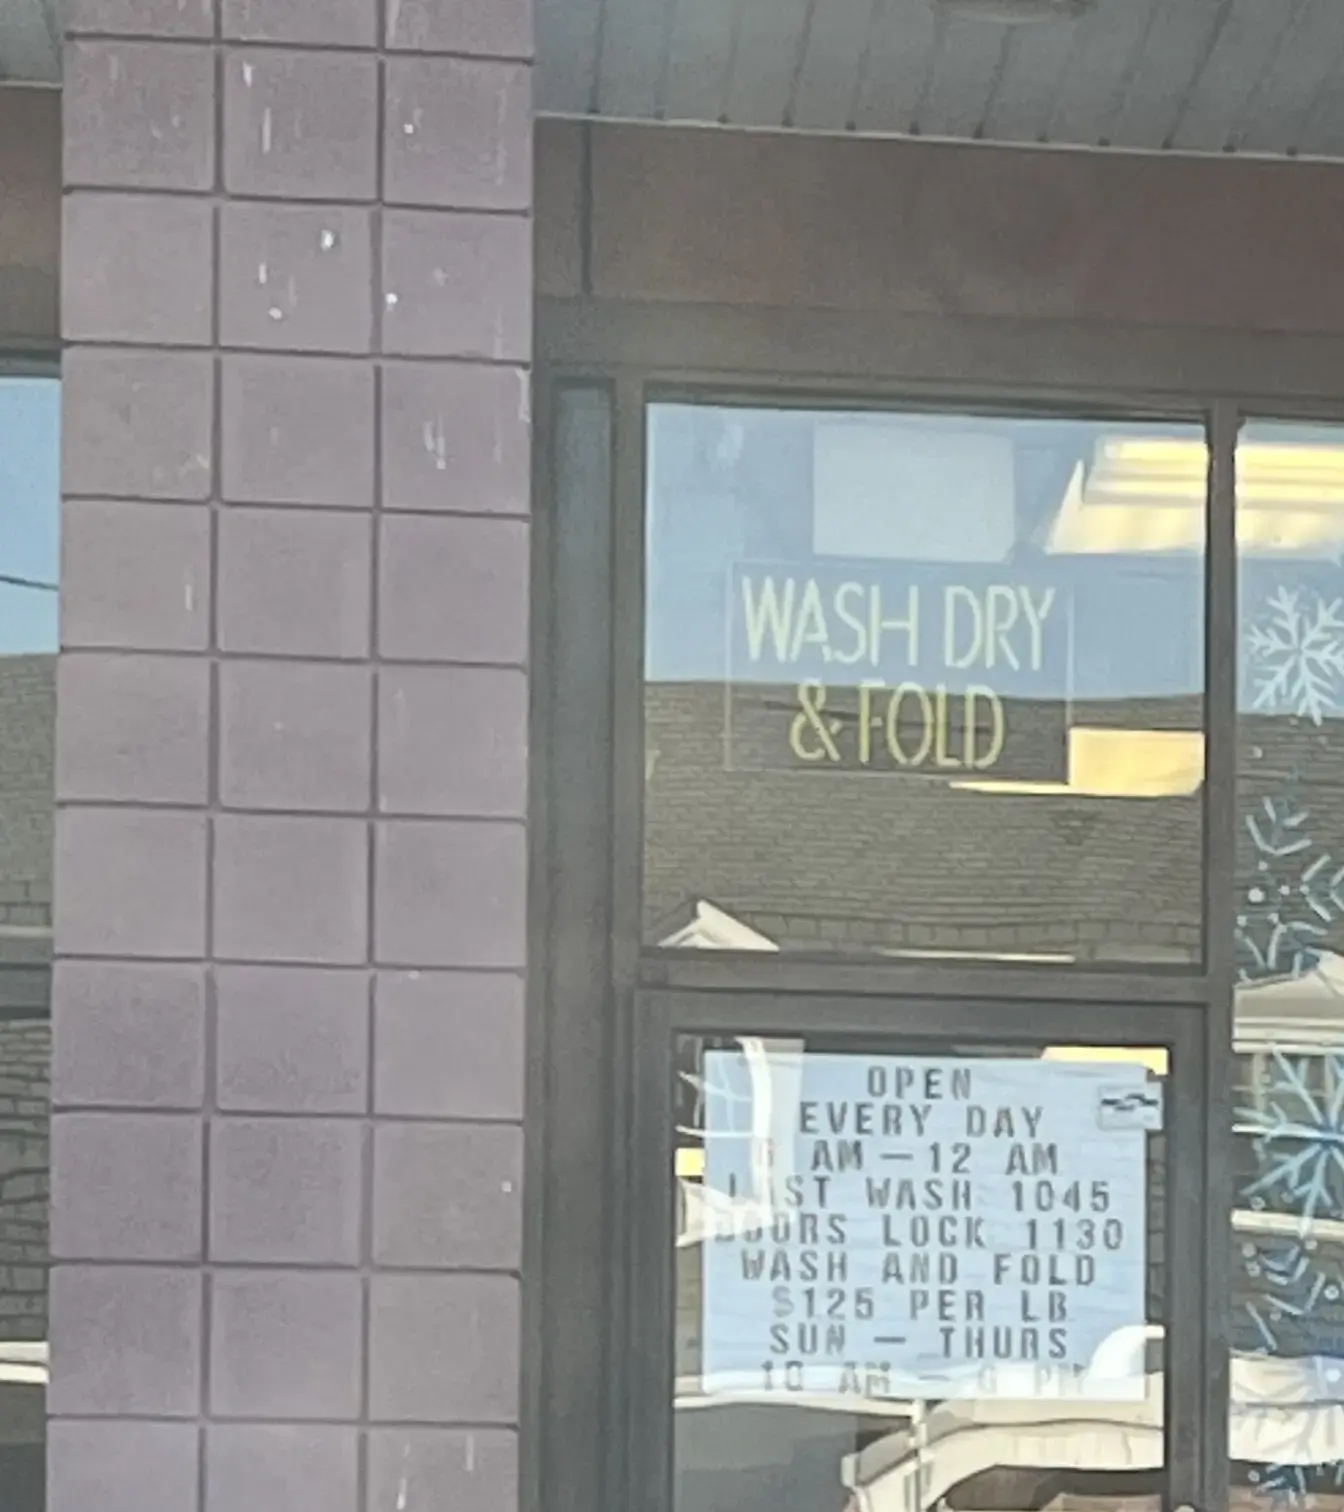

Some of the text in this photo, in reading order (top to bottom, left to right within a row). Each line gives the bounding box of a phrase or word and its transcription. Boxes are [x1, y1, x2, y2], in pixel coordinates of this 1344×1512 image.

[742, 576, 1056, 672] WASH DRY
[788, 678, 1005, 770] & FOLD
[867, 1065, 973, 1100] OPEN
[799, 1102, 1045, 1138] EVERY DAY
[1006, 1143, 1059, 1176] AM
[865, 1176, 972, 1211] WASH
[1011, 1180, 1111, 1212] 1045
[882, 1214, 987, 1249] LOCK
[1024, 1218, 1124, 1250] 1130
[741, 1249, 1097, 1287] WASH AND FOLD
[908, 1289, 986, 1321] PER
[1020, 1290, 1069, 1322] LB
[769, 1323, 847, 1357] SUN
[938, 1327, 1069, 1360] THURS
